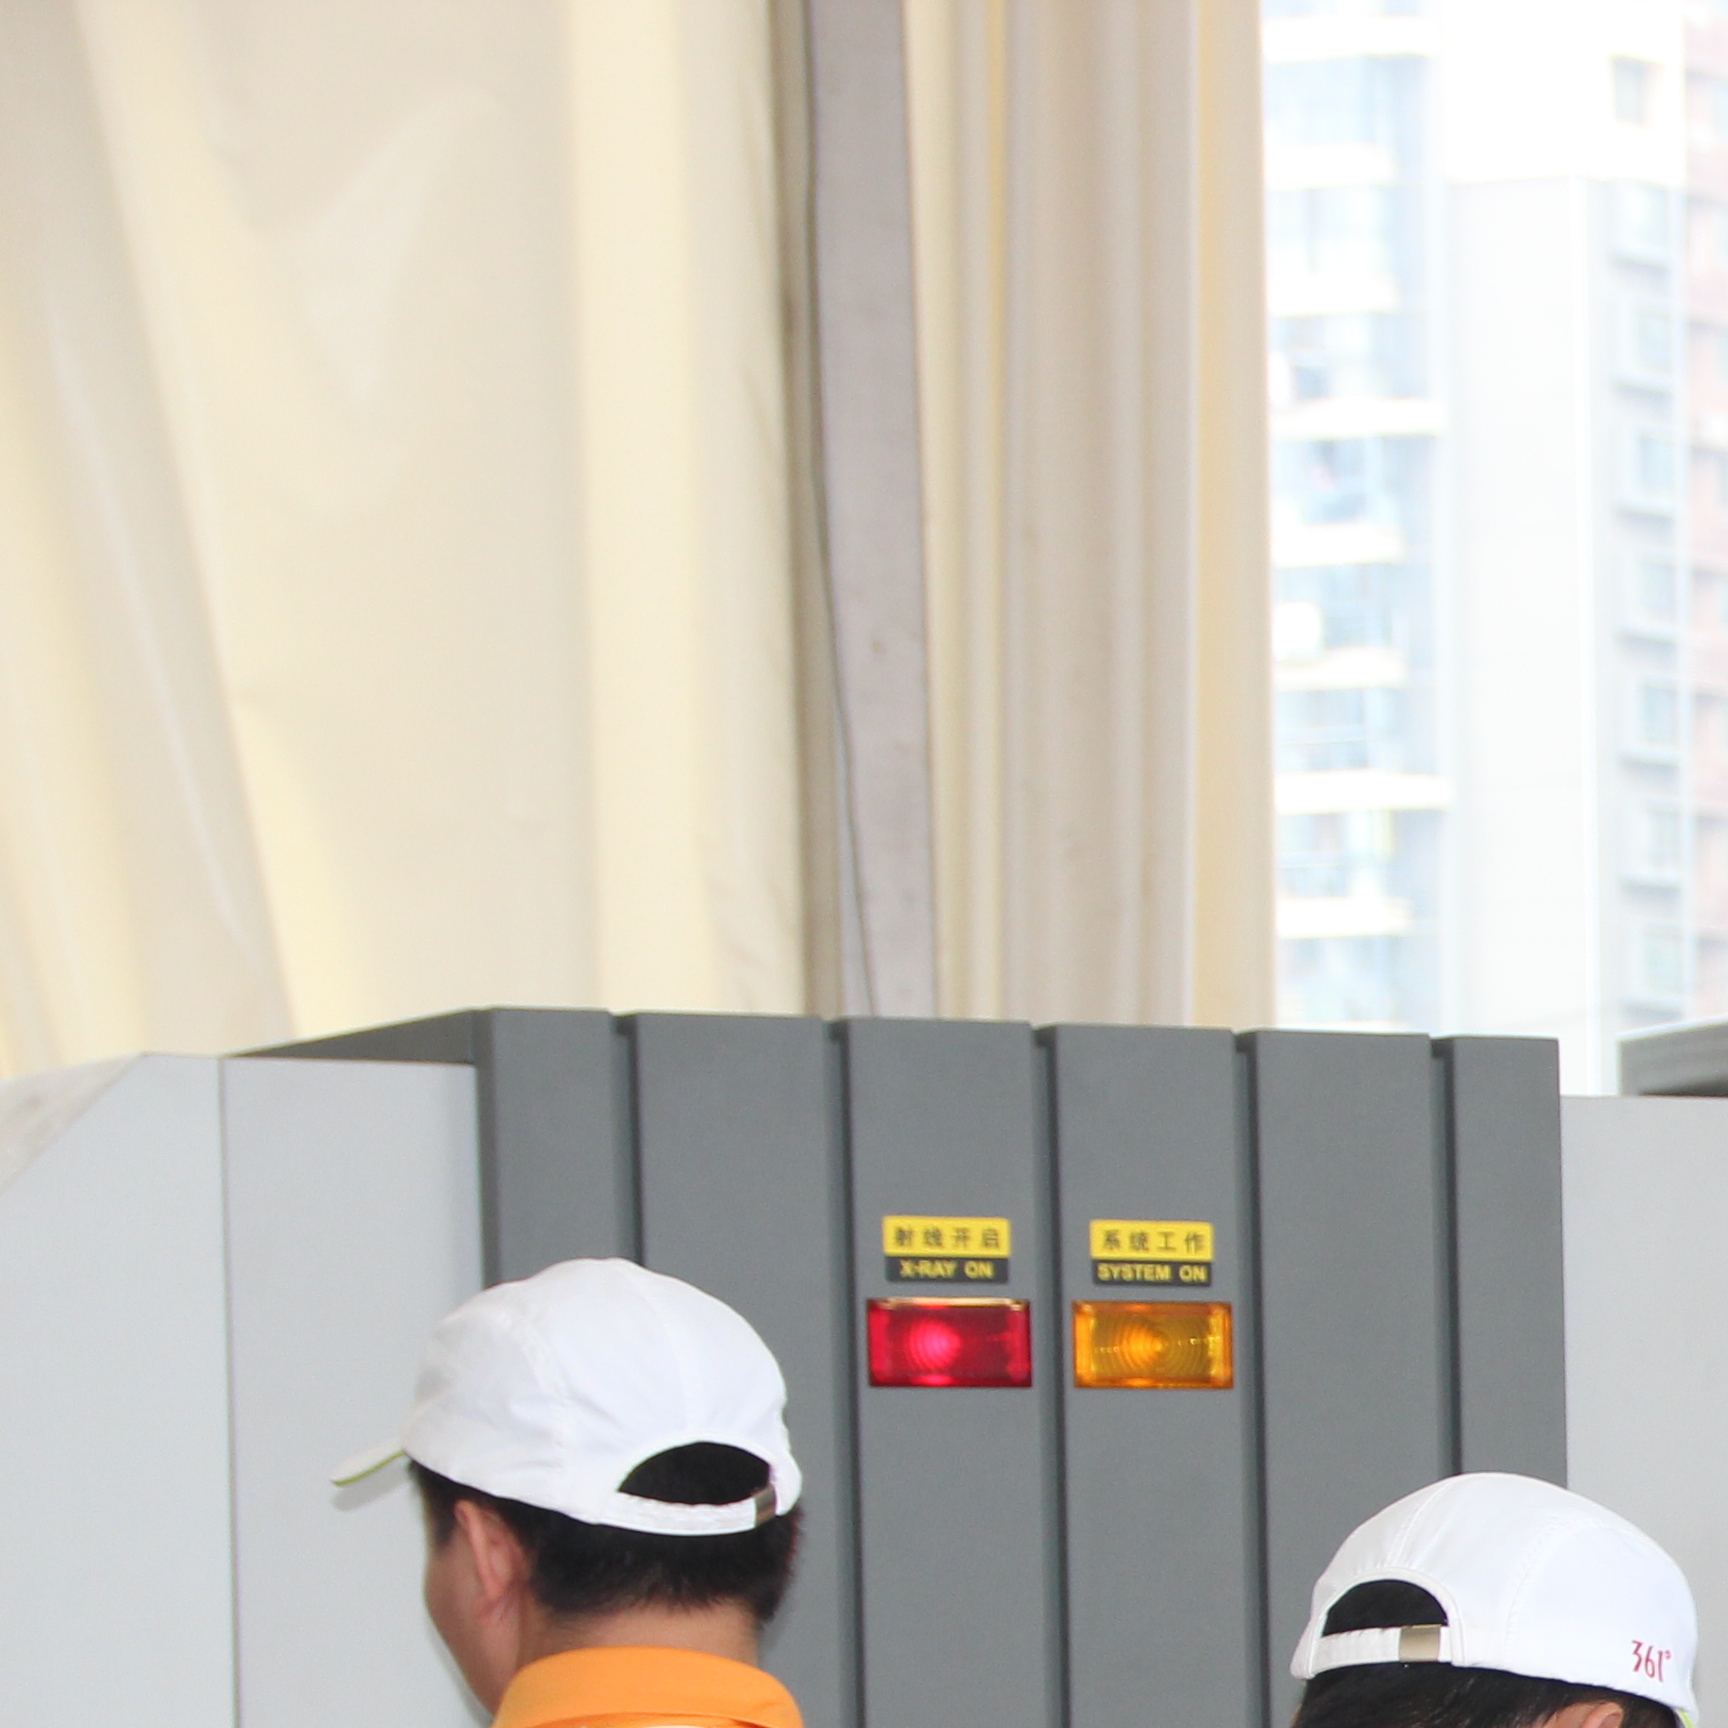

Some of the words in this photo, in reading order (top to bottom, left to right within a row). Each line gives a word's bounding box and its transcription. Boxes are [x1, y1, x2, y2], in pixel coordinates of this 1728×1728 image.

[895, 1224, 1000, 1248] 射线开启
[1103, 1228, 1204, 1253] 系统工作
[900, 1260, 956, 1279] X-RAY
[965, 1260, 994, 1279] ON
[1097, 1262, 1172, 1282] SYSTEM
[1179, 1263, 1207, 1283] ON
